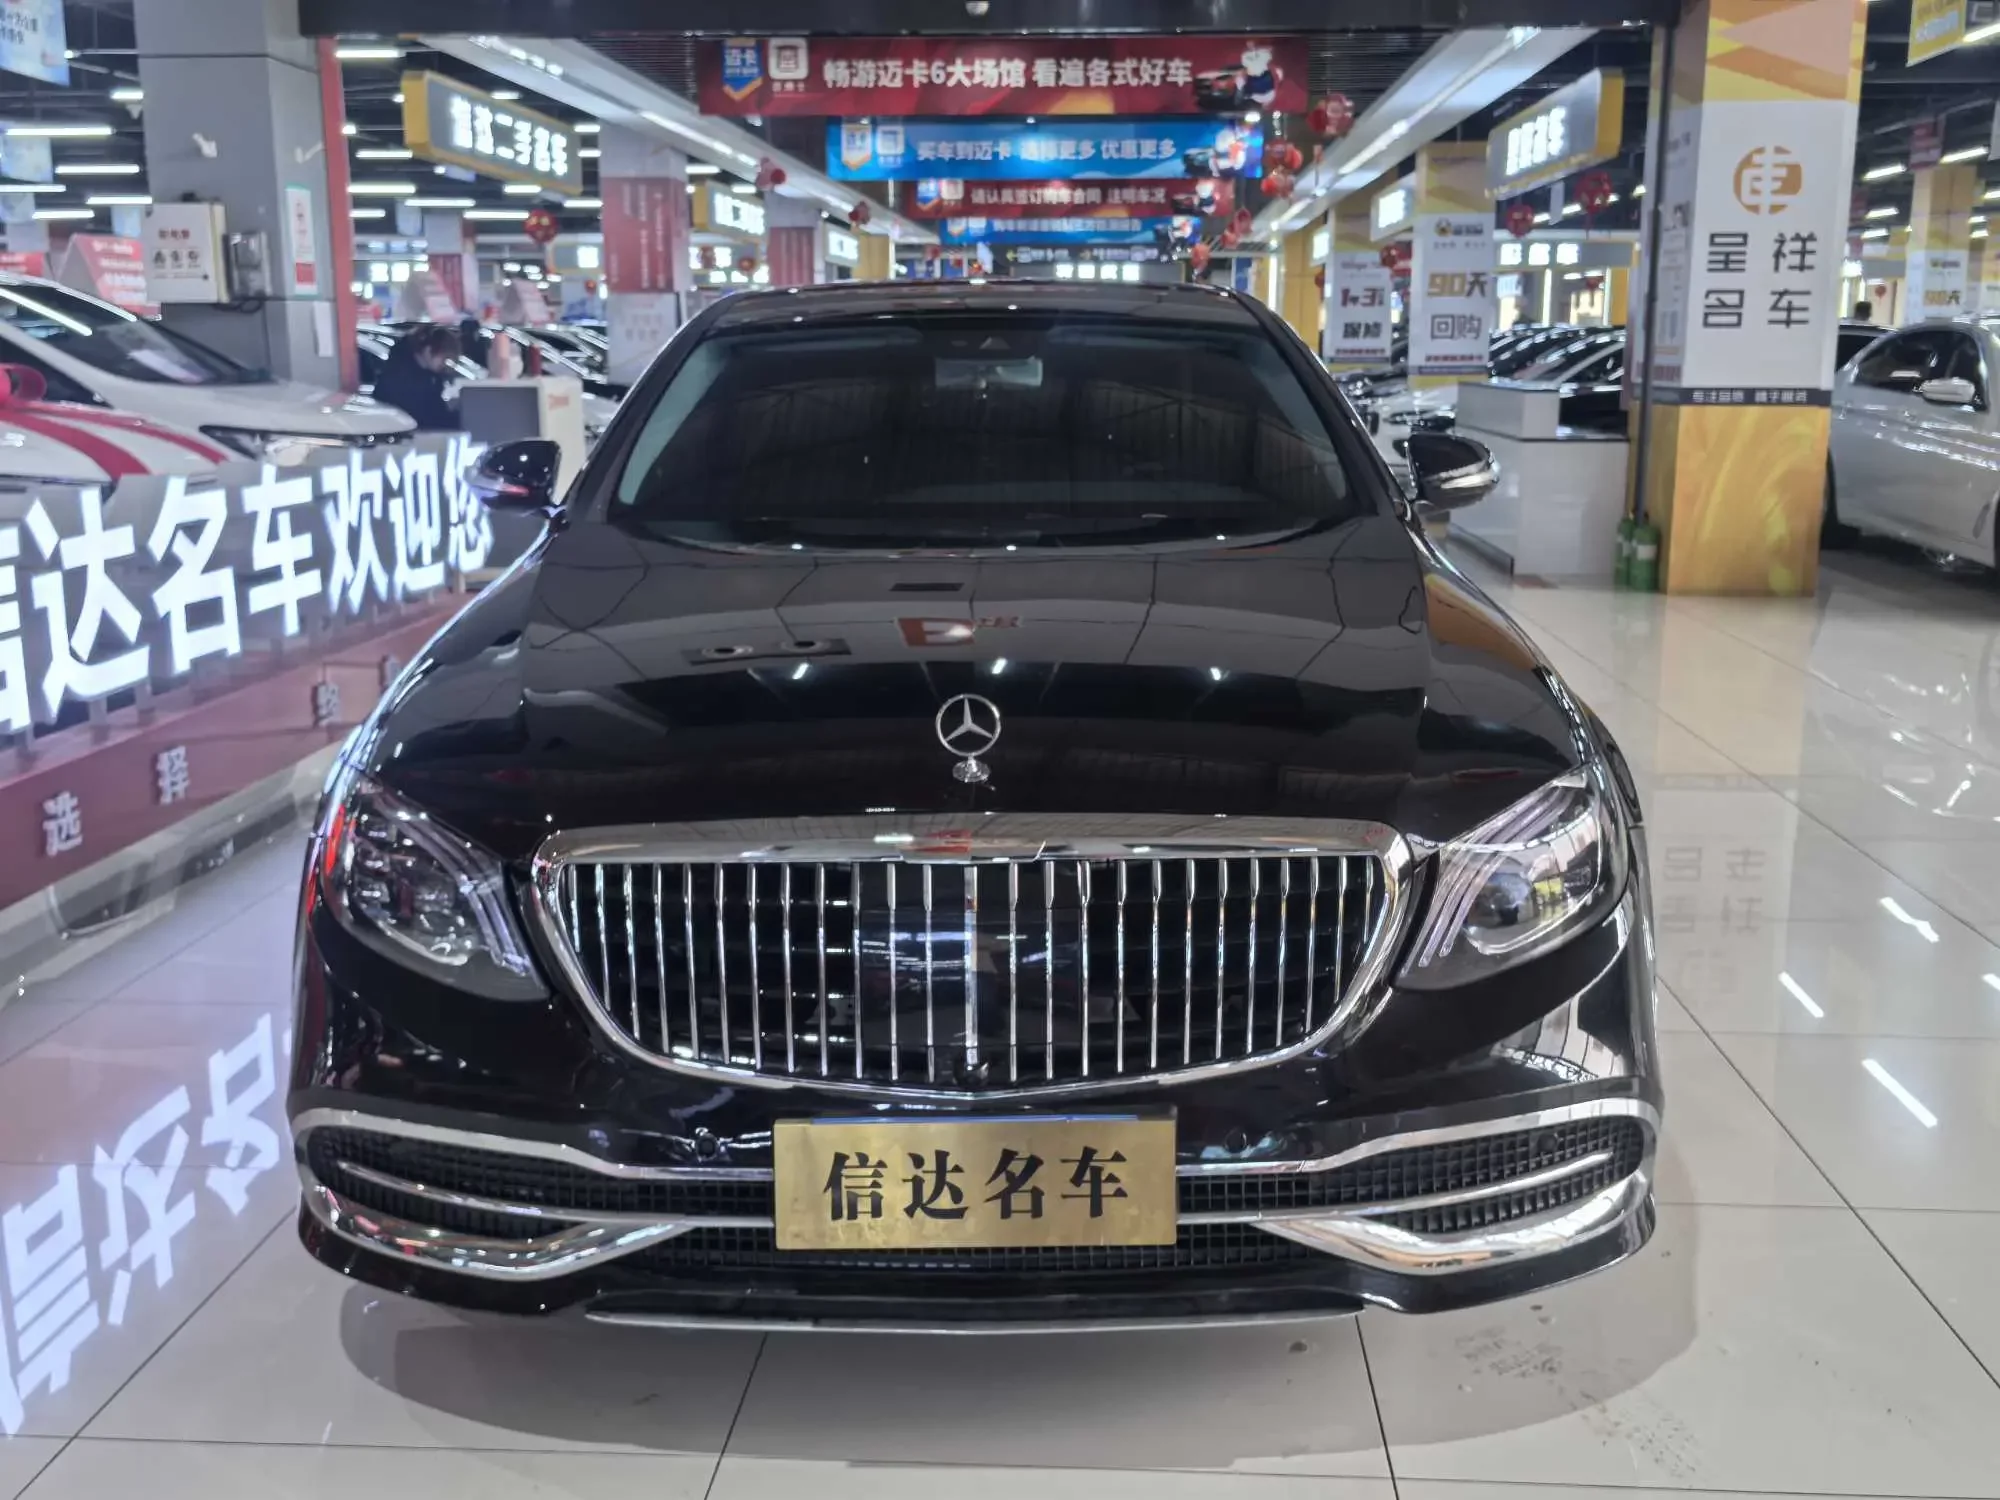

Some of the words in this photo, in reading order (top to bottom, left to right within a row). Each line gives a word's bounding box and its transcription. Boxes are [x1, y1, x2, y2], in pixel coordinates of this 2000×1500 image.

[823, 59, 1026, 88] 畅游迈卡6大场馆
[1032, 57, 1193, 88] 看遍各式好车
[917, 140, 1012, 162] 买车到迈卡
[1101, 138, 1177, 160] 优惠更多
[1706, 231, 1818, 273] 呈祥
[1427, 272, 1488, 298] 90天
[1702, 287, 1813, 329] 名车
[1430, 313, 1483, 341] 回购
[823, 1146, 1129, 1221] 信达名车
